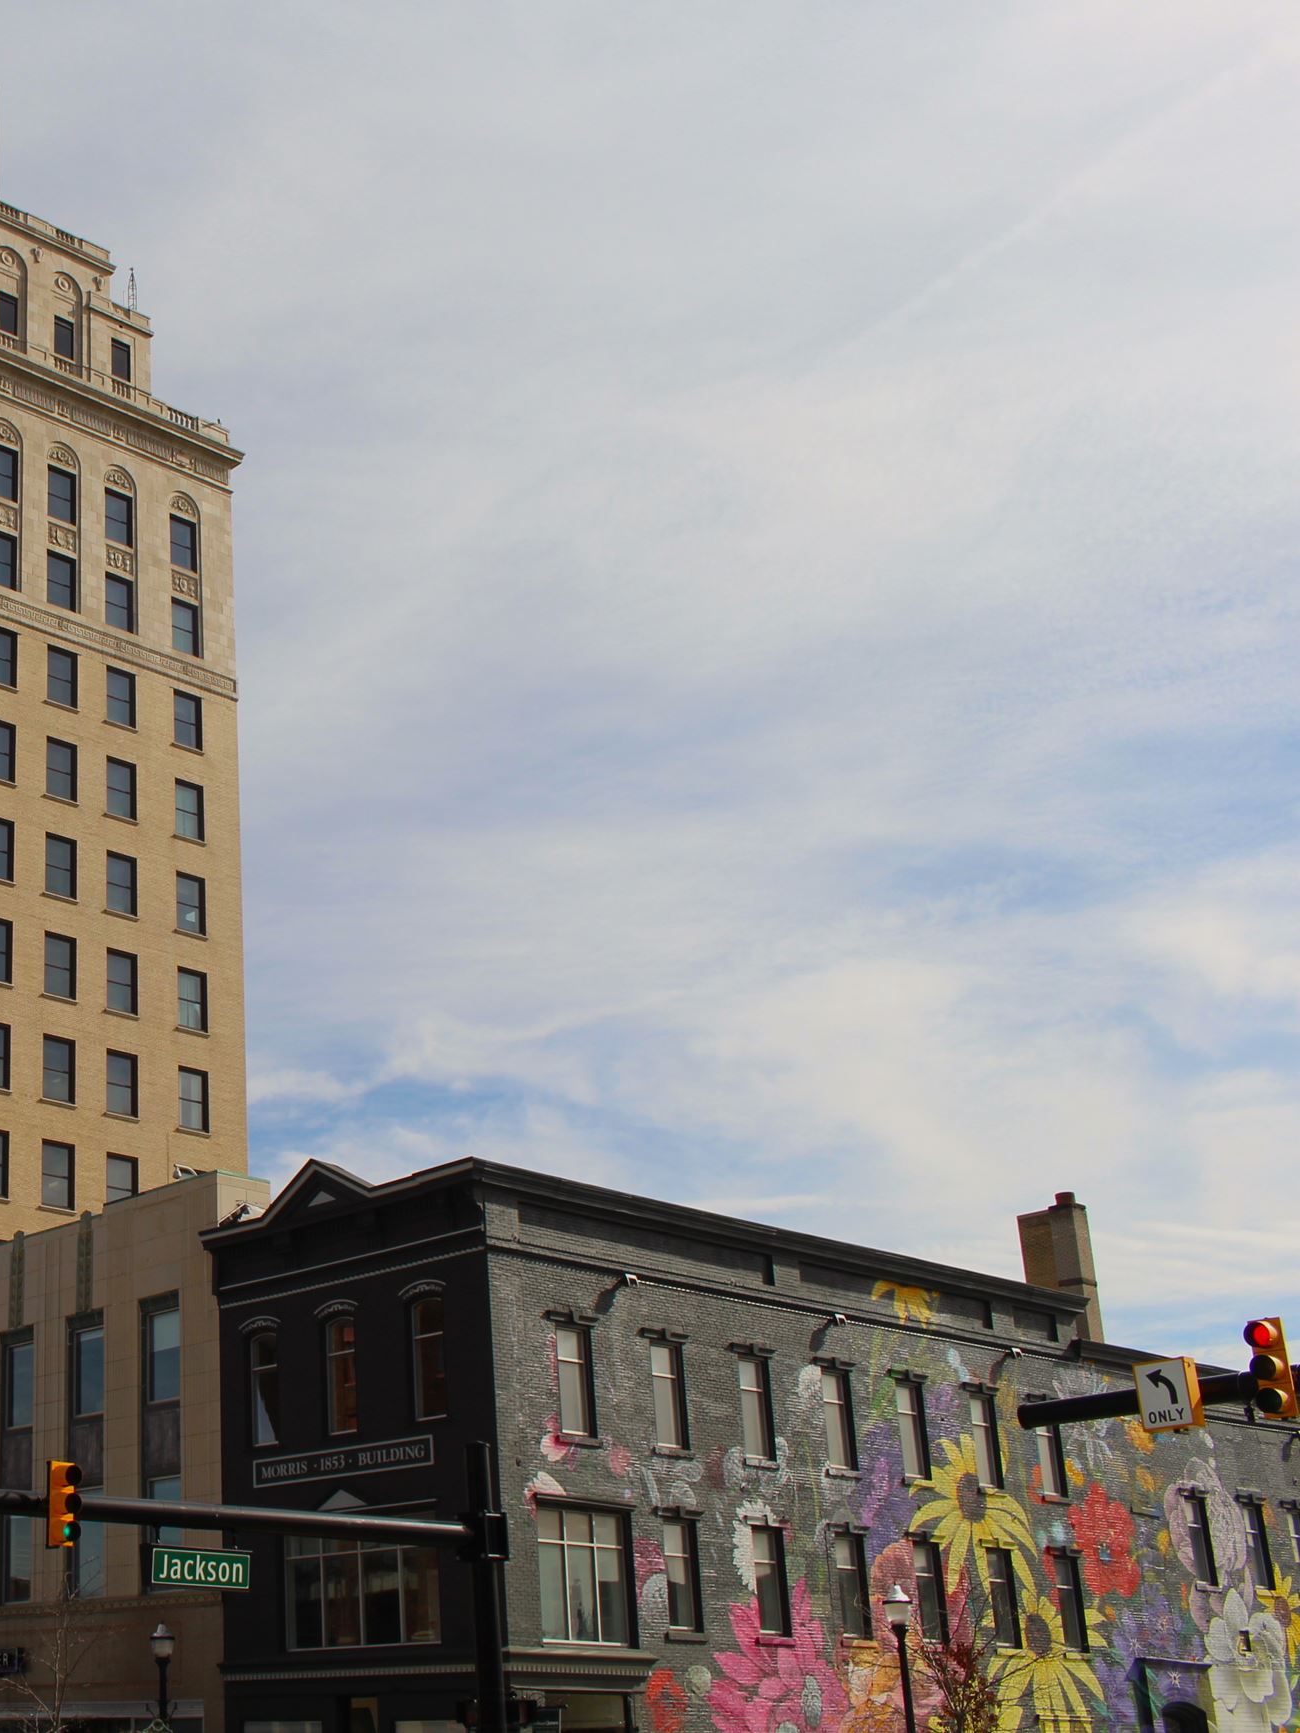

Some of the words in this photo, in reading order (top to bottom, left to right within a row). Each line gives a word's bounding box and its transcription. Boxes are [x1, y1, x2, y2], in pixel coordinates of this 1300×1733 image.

[1148, 1408, 1184, 1424] ONLY
[261, 1460, 308, 1479] MORRIS
[358, 1444, 425, 1466] BUILDING
[159, 1554, 243, 1583] Jackson
